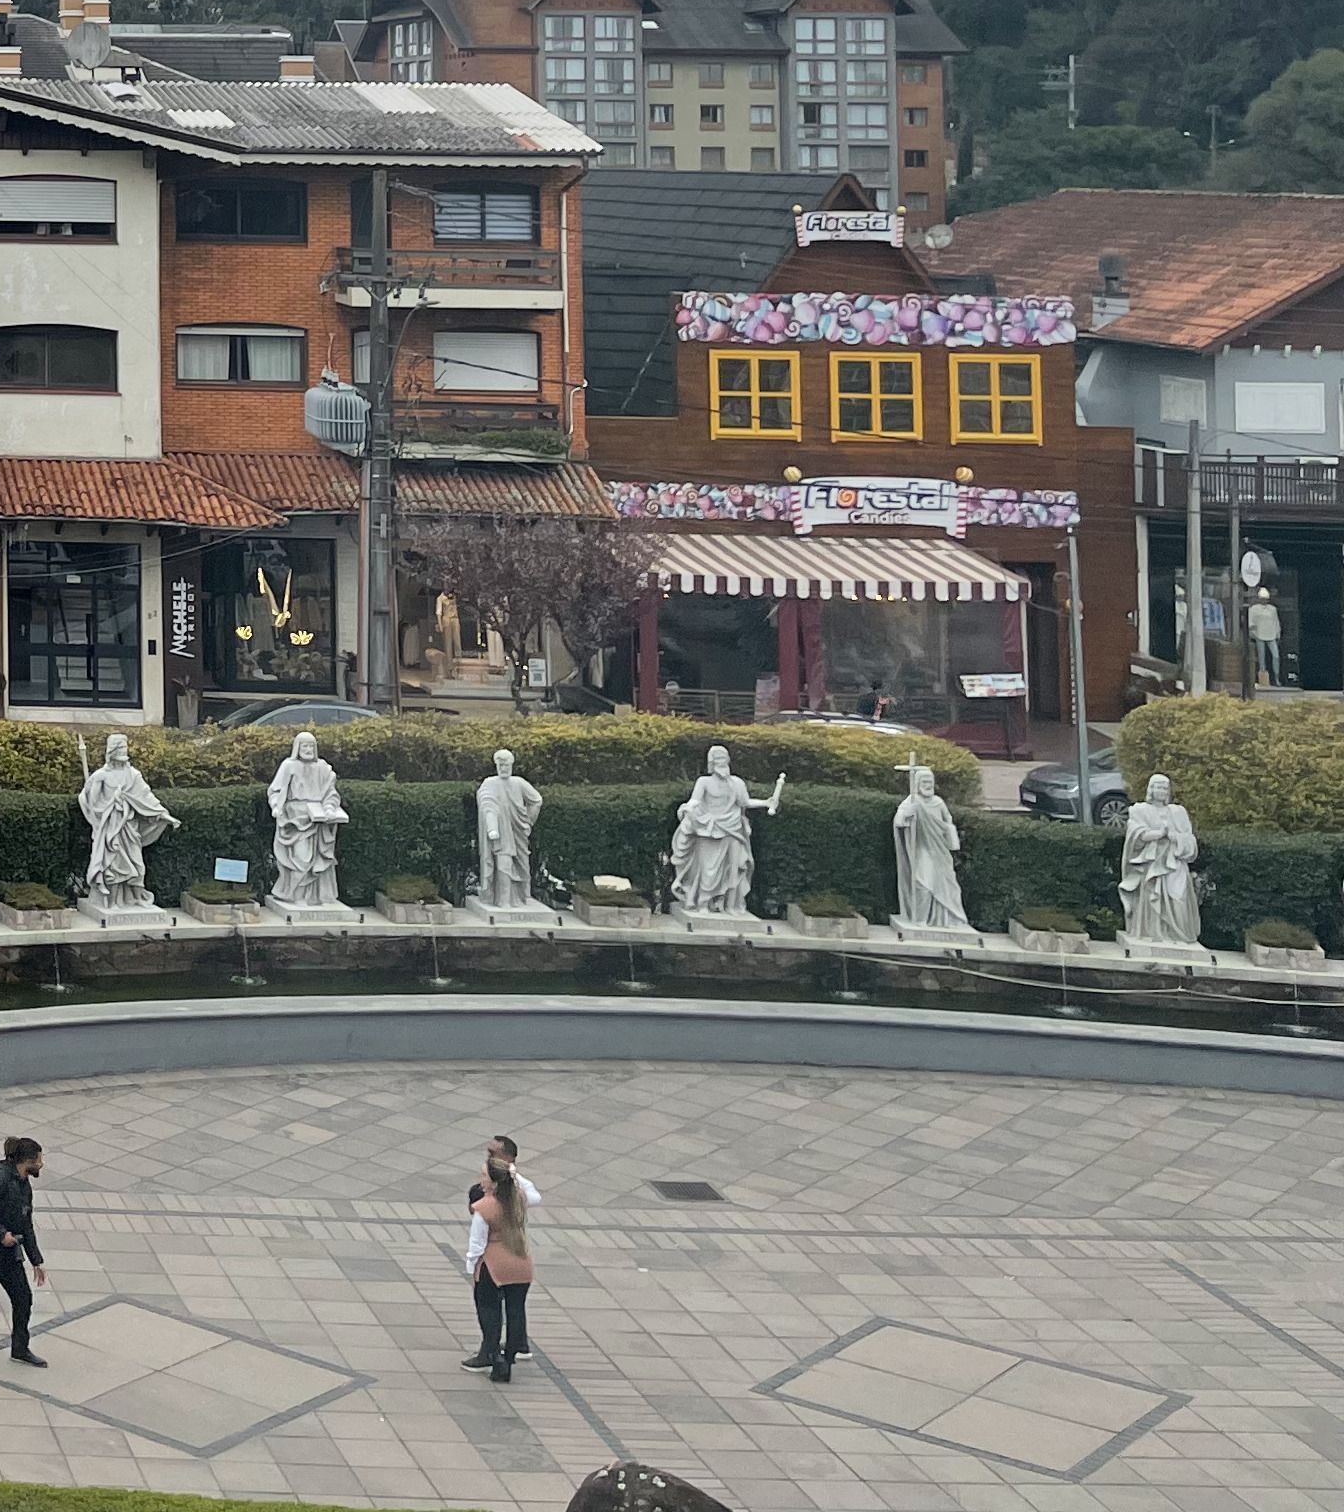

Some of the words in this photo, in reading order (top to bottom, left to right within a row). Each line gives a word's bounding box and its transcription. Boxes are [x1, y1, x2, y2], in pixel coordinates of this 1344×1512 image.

[807, 213, 892, 231] Florestal
[804, 481, 954, 510] Florestal
[848, 510, 912, 524] Candies
